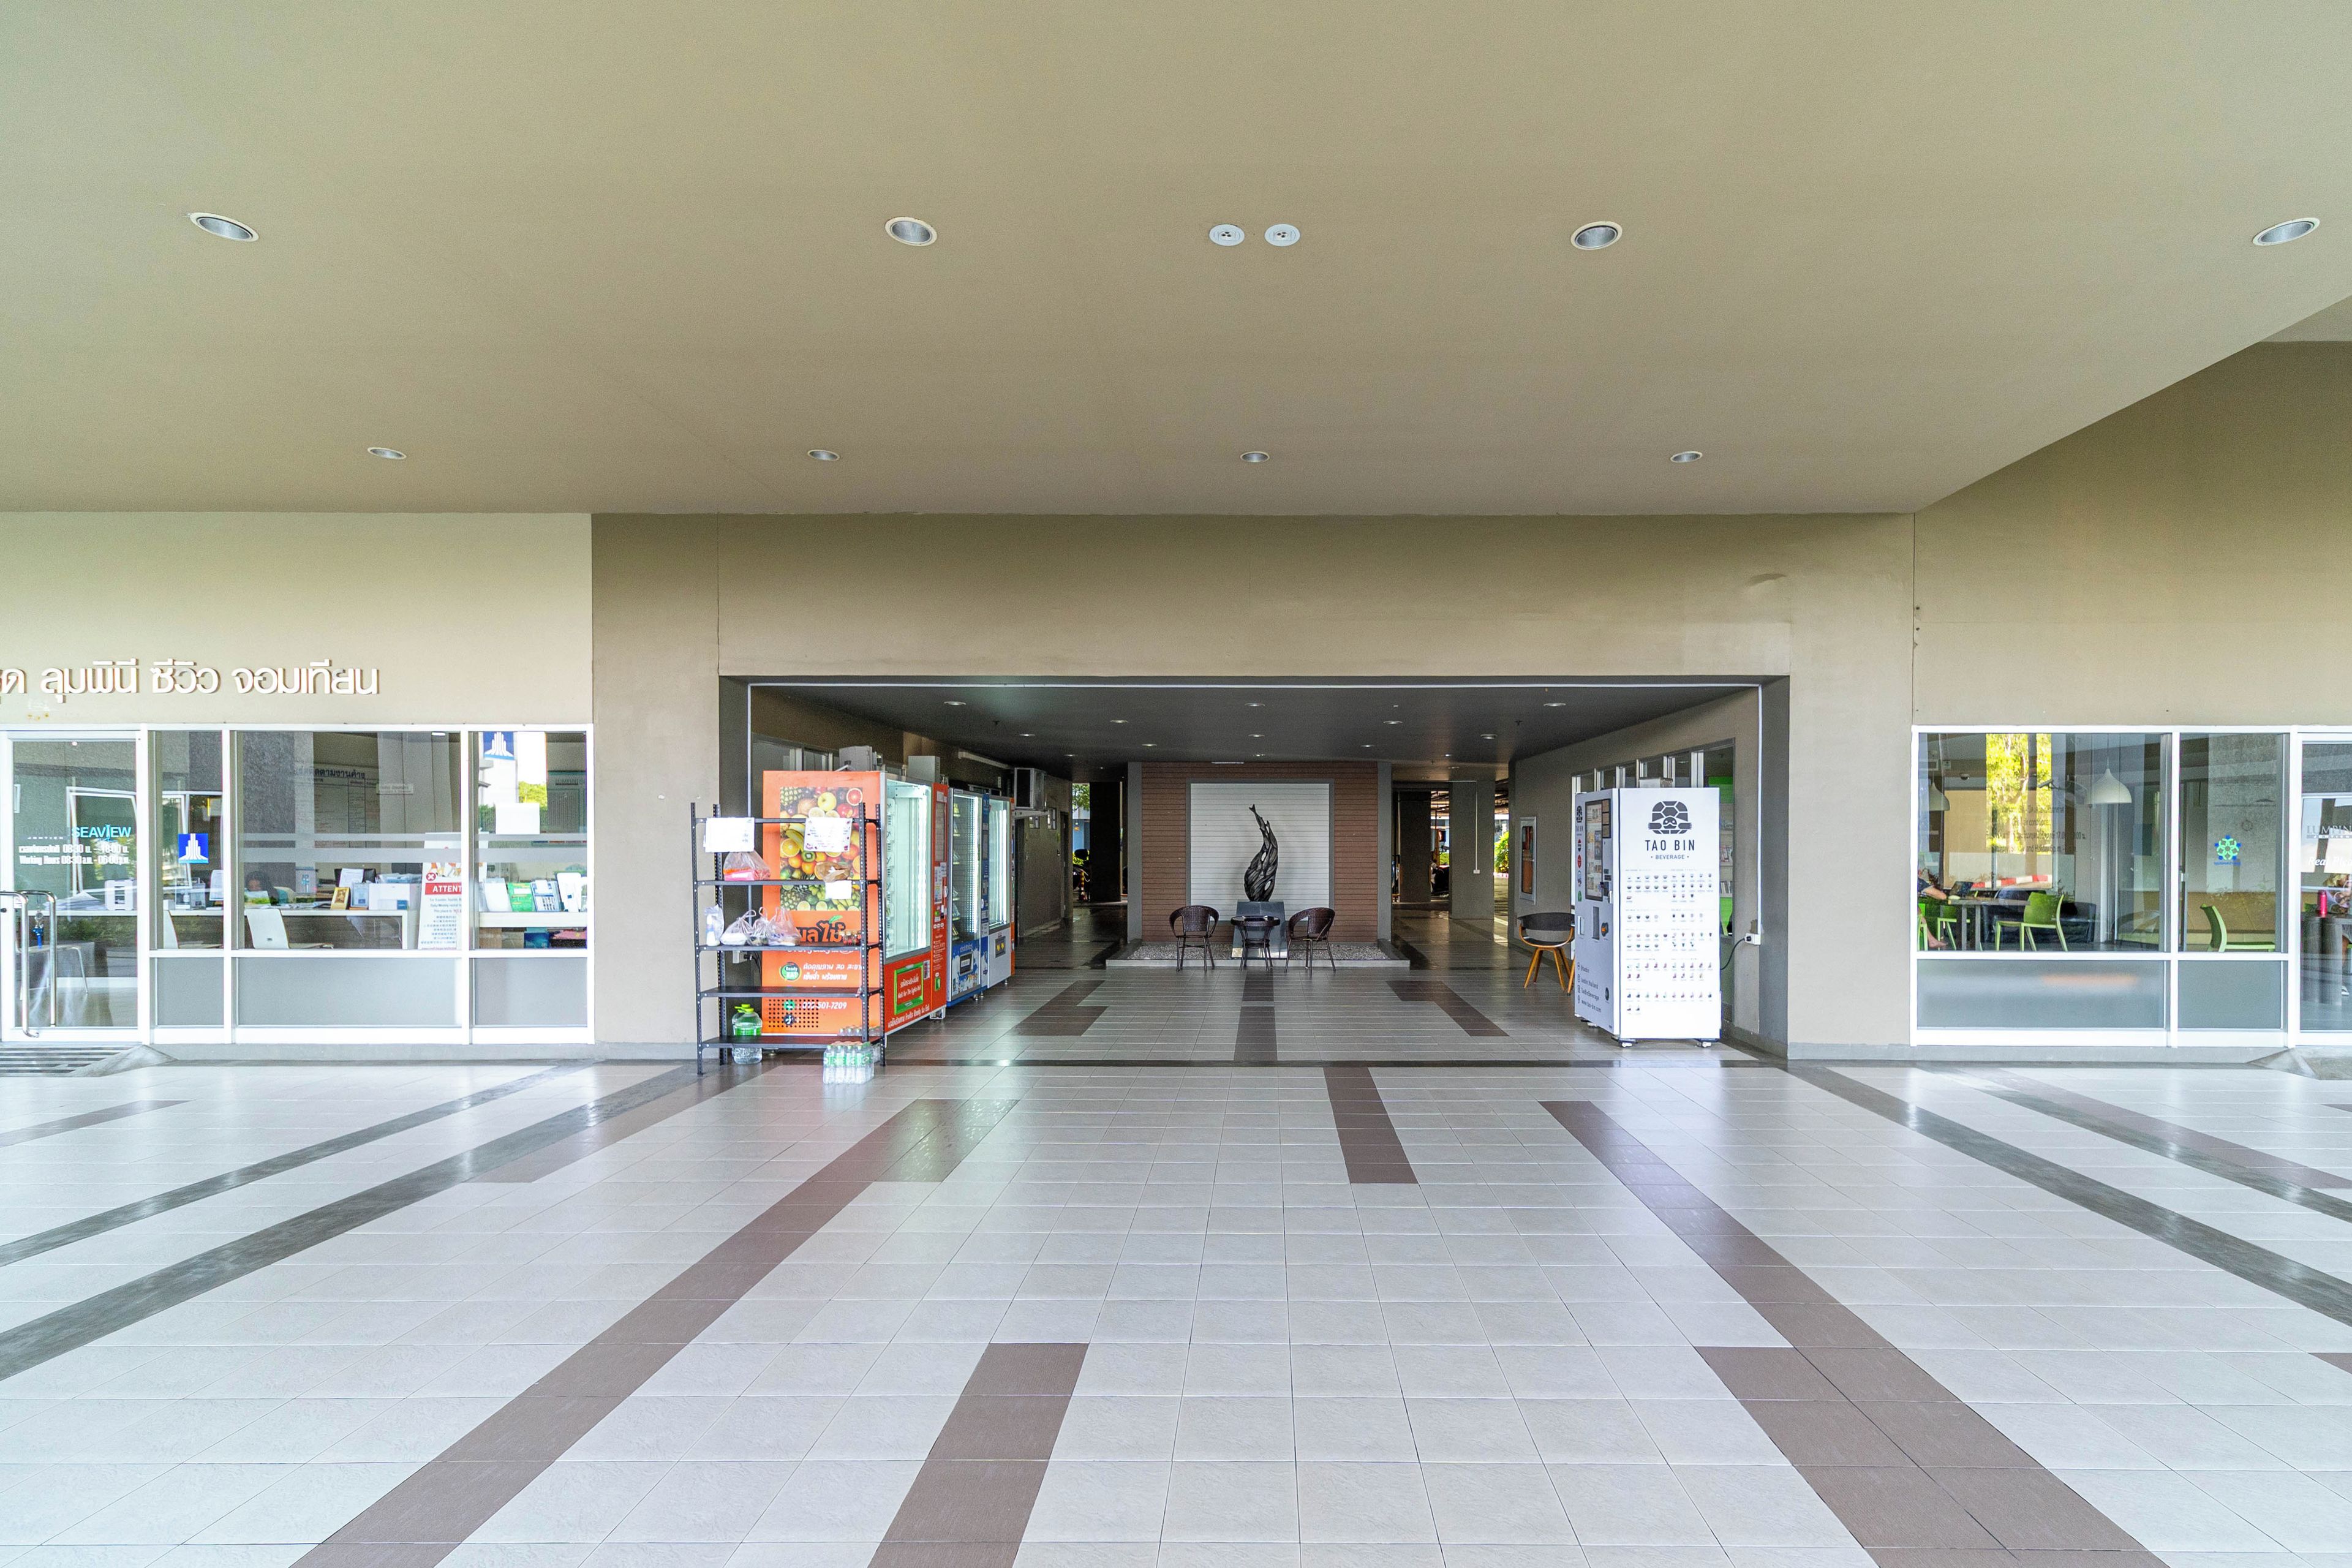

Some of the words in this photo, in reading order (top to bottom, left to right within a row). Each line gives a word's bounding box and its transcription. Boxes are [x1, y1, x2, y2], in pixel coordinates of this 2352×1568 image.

[40, 658, 138, 703] ลุมพินี
[150, 658, 220, 694] ซีวิว
[232, 658, 380, 695] จอมเทียน
[72, 824, 132, 838] SEAVIEW
[2306, 825, 2352, 834] LUMPIN
[1645, 840, 1667, 851] TAO
[1674, 840, 1695, 851] BIN
